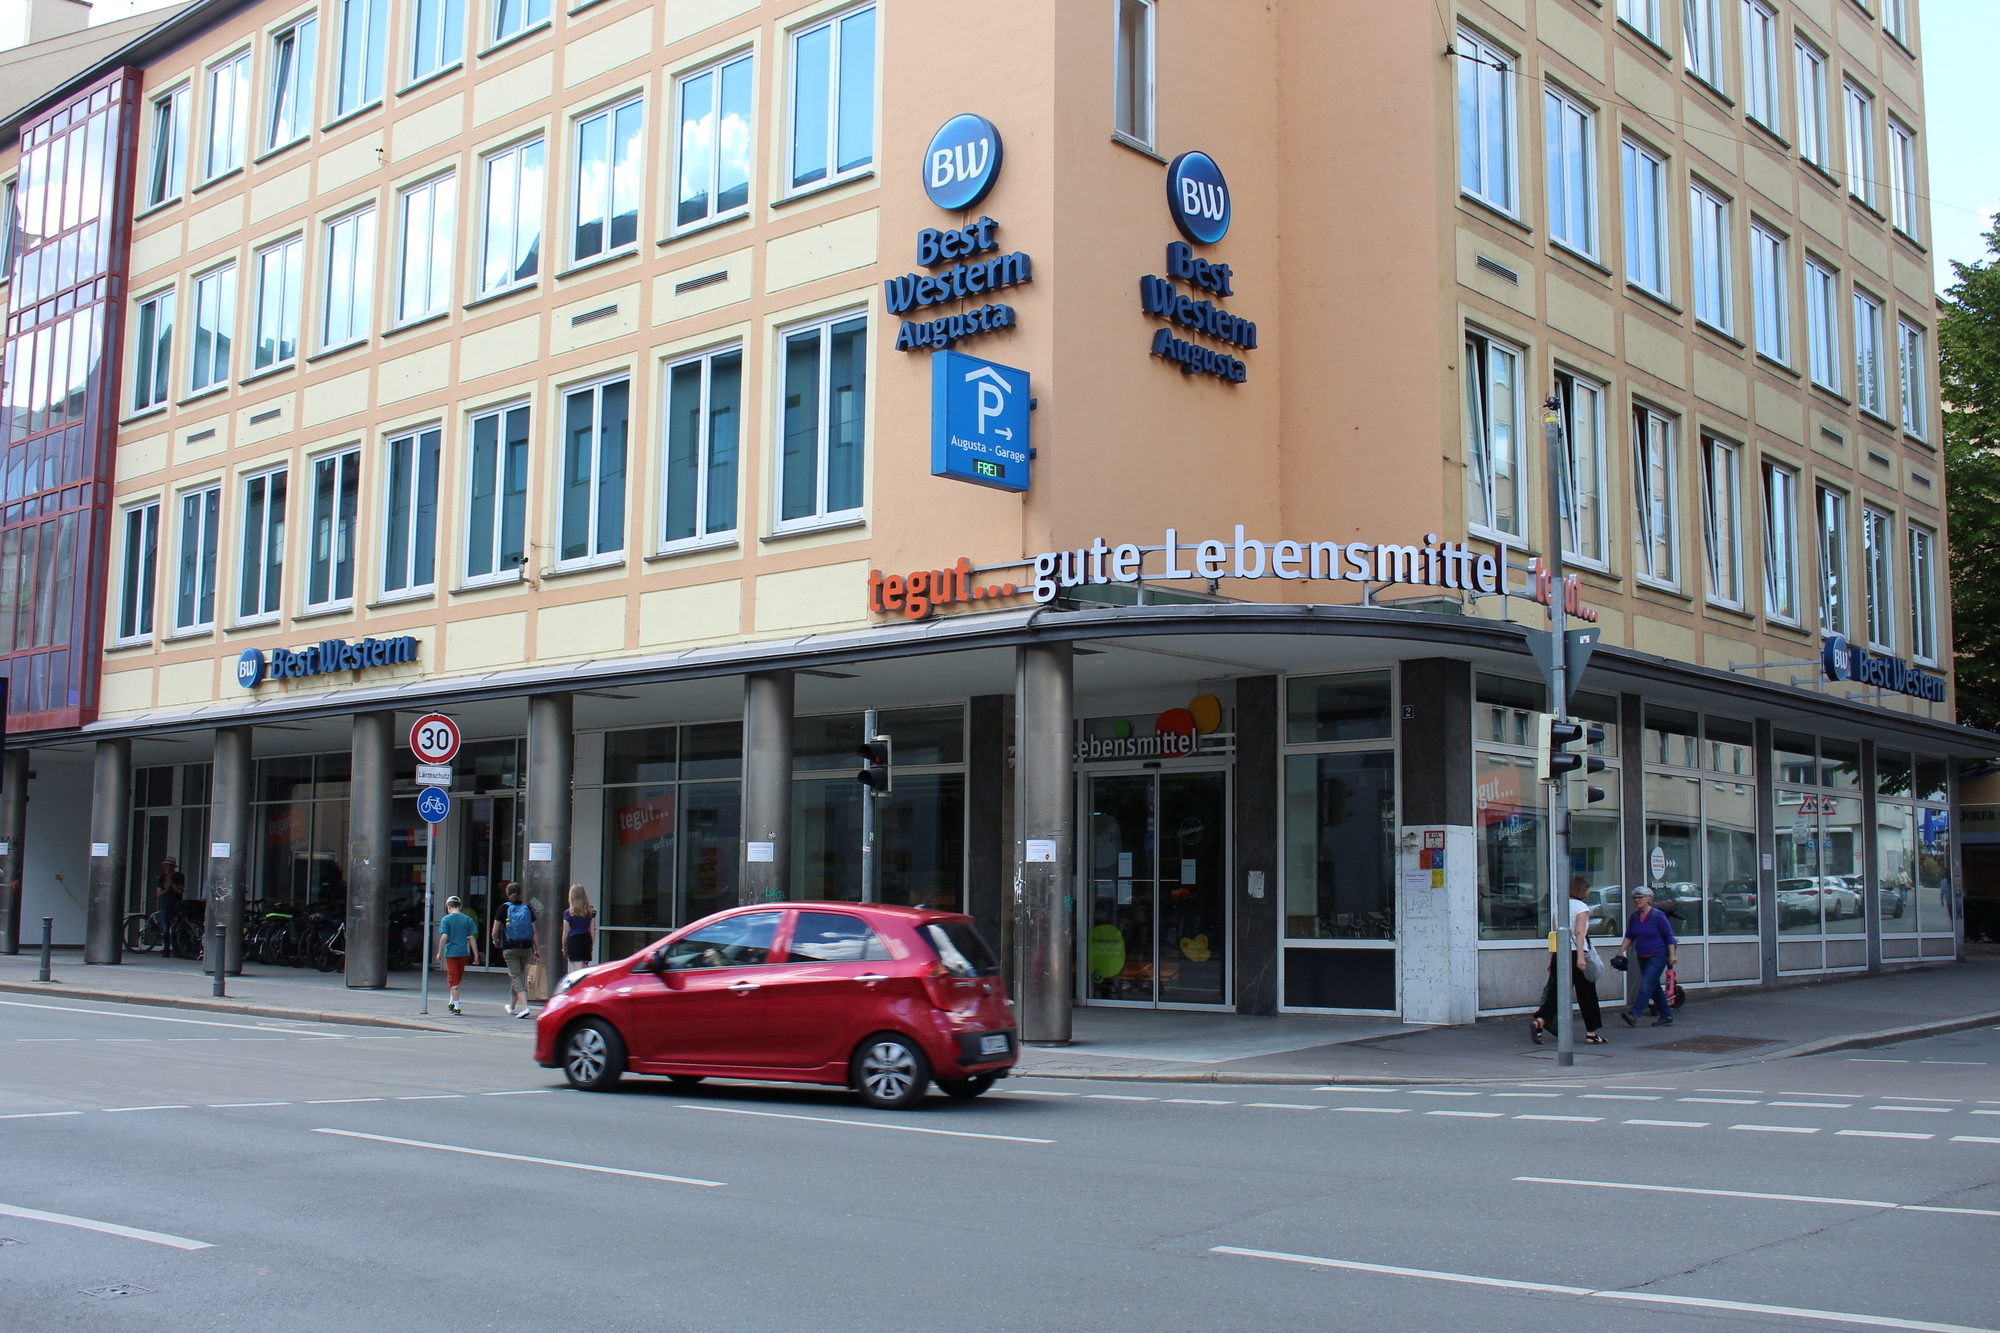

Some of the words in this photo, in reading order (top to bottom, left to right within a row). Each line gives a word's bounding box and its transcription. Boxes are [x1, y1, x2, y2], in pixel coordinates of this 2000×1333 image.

[931, 138, 988, 188] BW
[1181, 177, 1225, 221] BW
[917, 215, 998, 267] Best
[884, 251, 1032, 316] Western
[1168, 241, 1234, 297] Best
[895, 303, 1016, 351] Augusta
[1142, 274, 1258, 350] Western
[1151, 328, 1247, 384] Augusta
[978, 381, 1004, 435] P
[951, 435, 986, 453] Augusta
[995, 445, 1026, 463] Garage
[977, 461, 997, 477] FREI
[868, 556, 1017, 619] tegut...
[1033, 537, 1142, 603] gute
[1166, 524, 1510, 595] Lebensmittel
[239, 659, 256, 678] BW
[270, 647, 319, 679] Best
[319, 636, 417, 673] Western
[1834, 649, 1848, 669] BW
[1852, 648, 1891, 689] Best
[1893, 656, 1946, 702] Western
[1405, 706, 1411, 717] 2
[421, 727, 449, 750] 30
[418, 770, 450, 780] Lärmschutz
[619, 803, 669, 831] tegut...
[1959, 810, 1996, 823] JOKER
